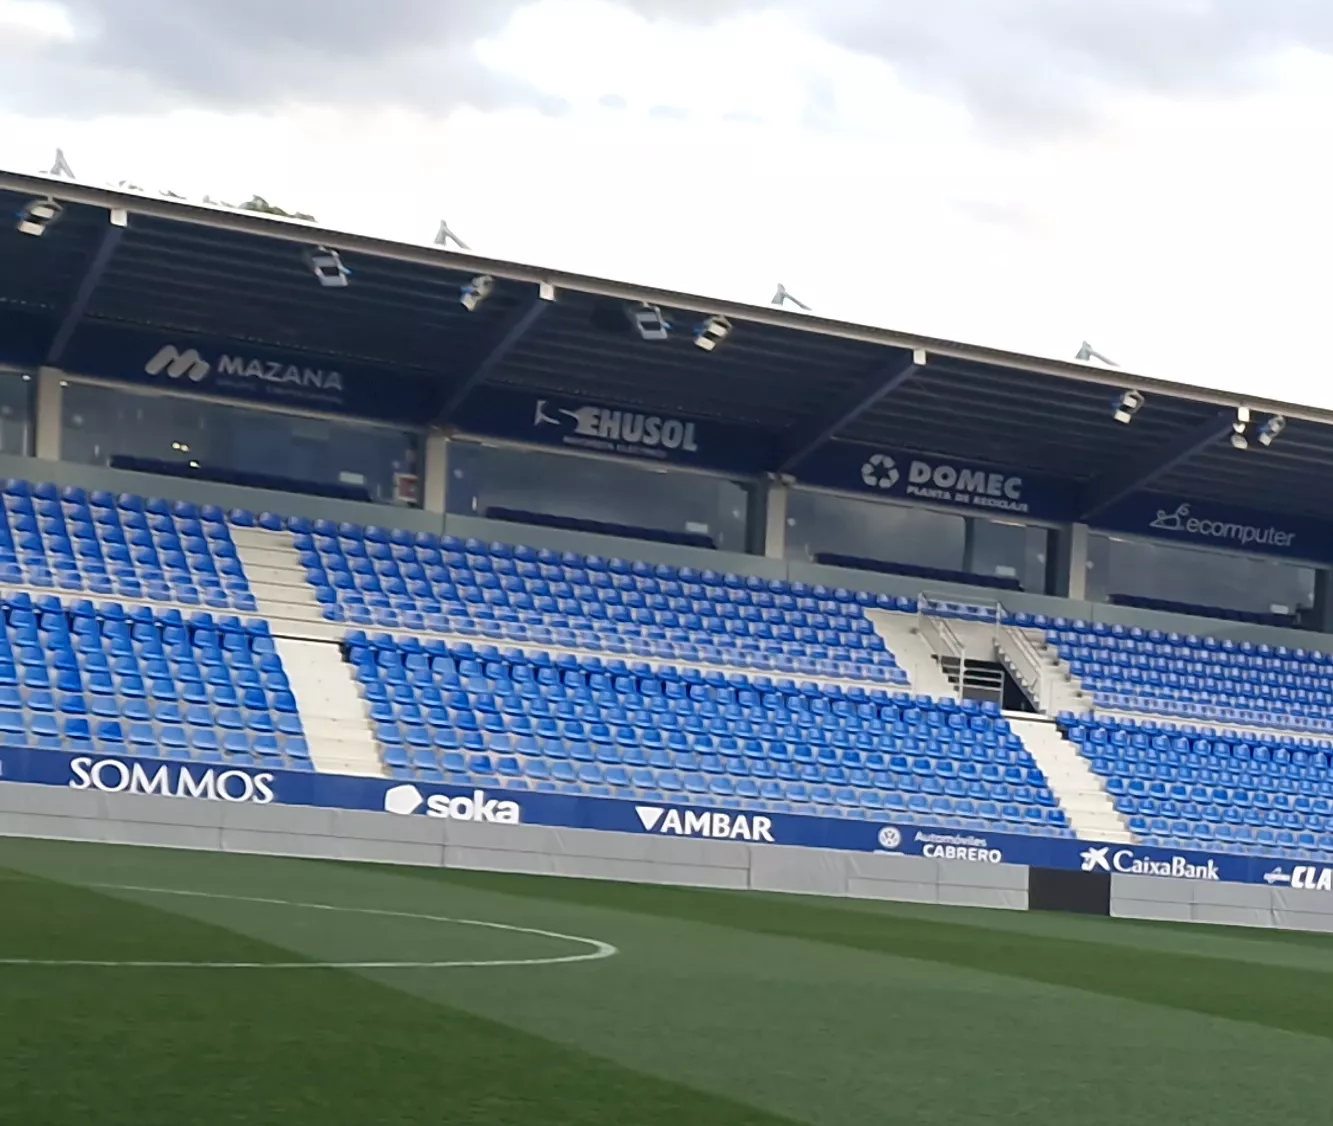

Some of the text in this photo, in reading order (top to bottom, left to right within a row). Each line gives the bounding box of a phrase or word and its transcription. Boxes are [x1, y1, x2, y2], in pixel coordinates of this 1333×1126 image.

[216, 353, 343, 391] MAZANA
[573, 405, 698, 452] EHUSOL
[908, 460, 1023, 500] DOMEC
[1186, 517, 1296, 547] ecomputer
[68, 757, 275, 804] SOMMOS
[426, 789, 520, 825] soka
[660, 808, 776, 842] AMBAR
[923, 844, 1002, 864] CABRERO
[1112, 849, 1220, 880] CaixaBank
